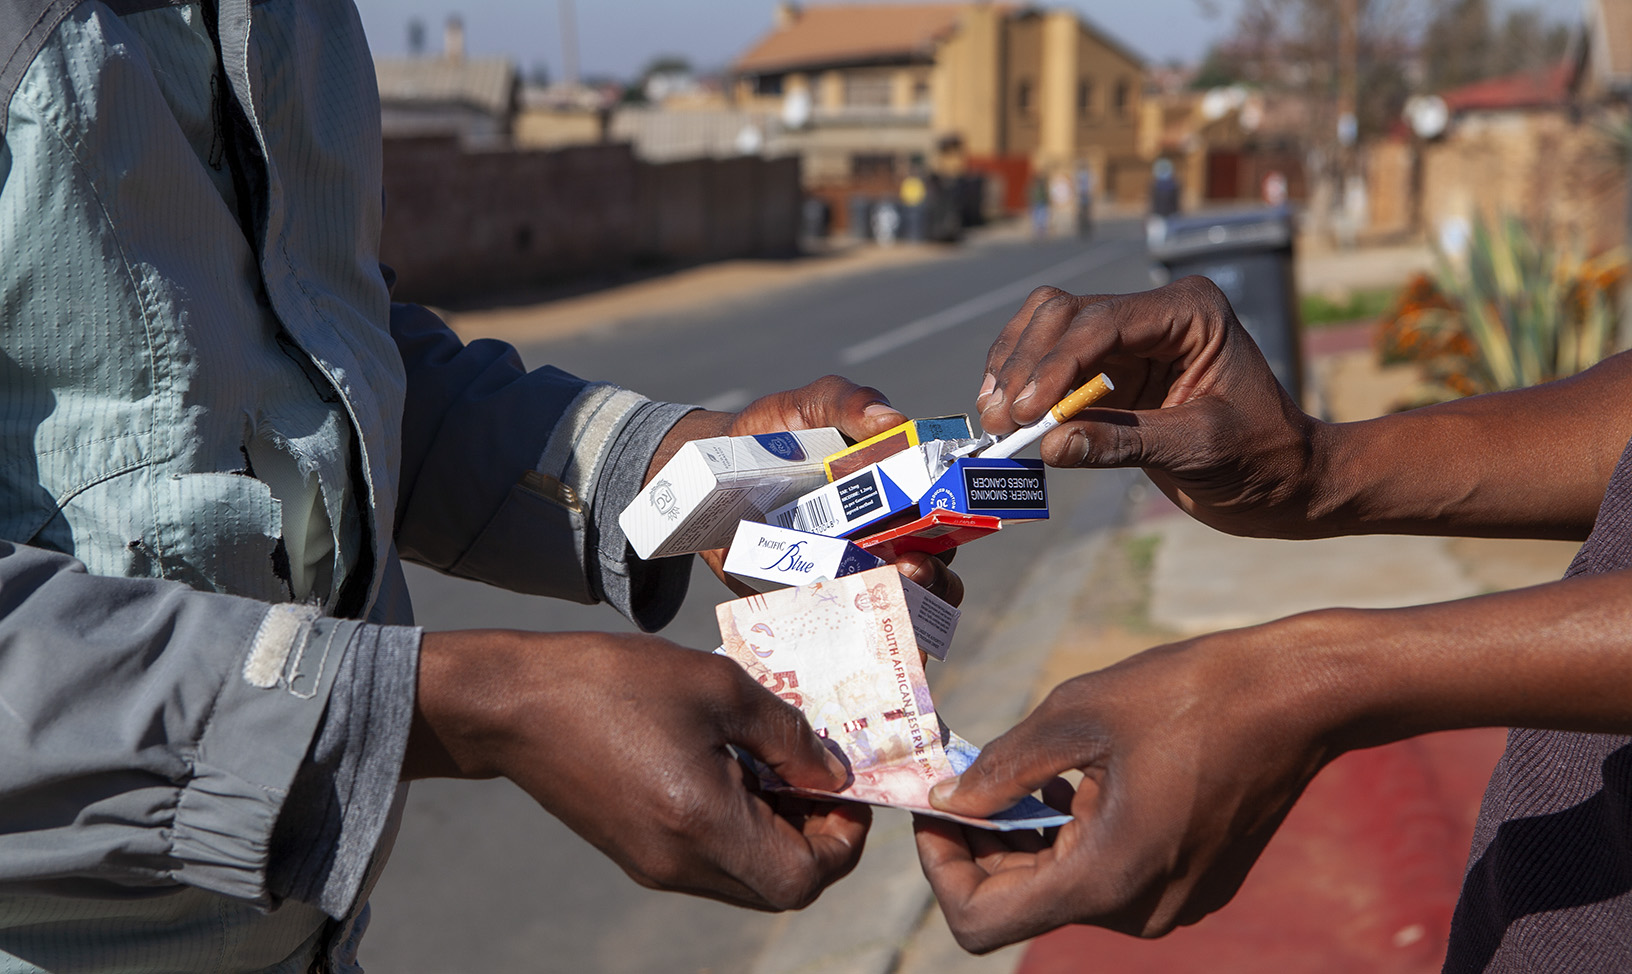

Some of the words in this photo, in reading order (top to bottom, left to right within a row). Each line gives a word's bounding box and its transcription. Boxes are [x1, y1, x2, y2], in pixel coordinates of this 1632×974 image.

[972, 477, 1007, 488] CANCER
[1007, 477, 1039, 488] CAUSES
[657, 488, 673, 509] RG
[970, 489, 1008, 501] SMOKING
[1009, 489, 1044, 501] DANGER:
[936, 498, 949, 509] 20
[758, 536, 787, 551] PACIFIC
[760, 540, 815, 574] Blue
[881, 617, 900, 656] SOUTH
[892, 660, 913, 708] AFRICAN
[905, 710, 925, 755] RESERVE
[917, 755, 935, 780] BANK
